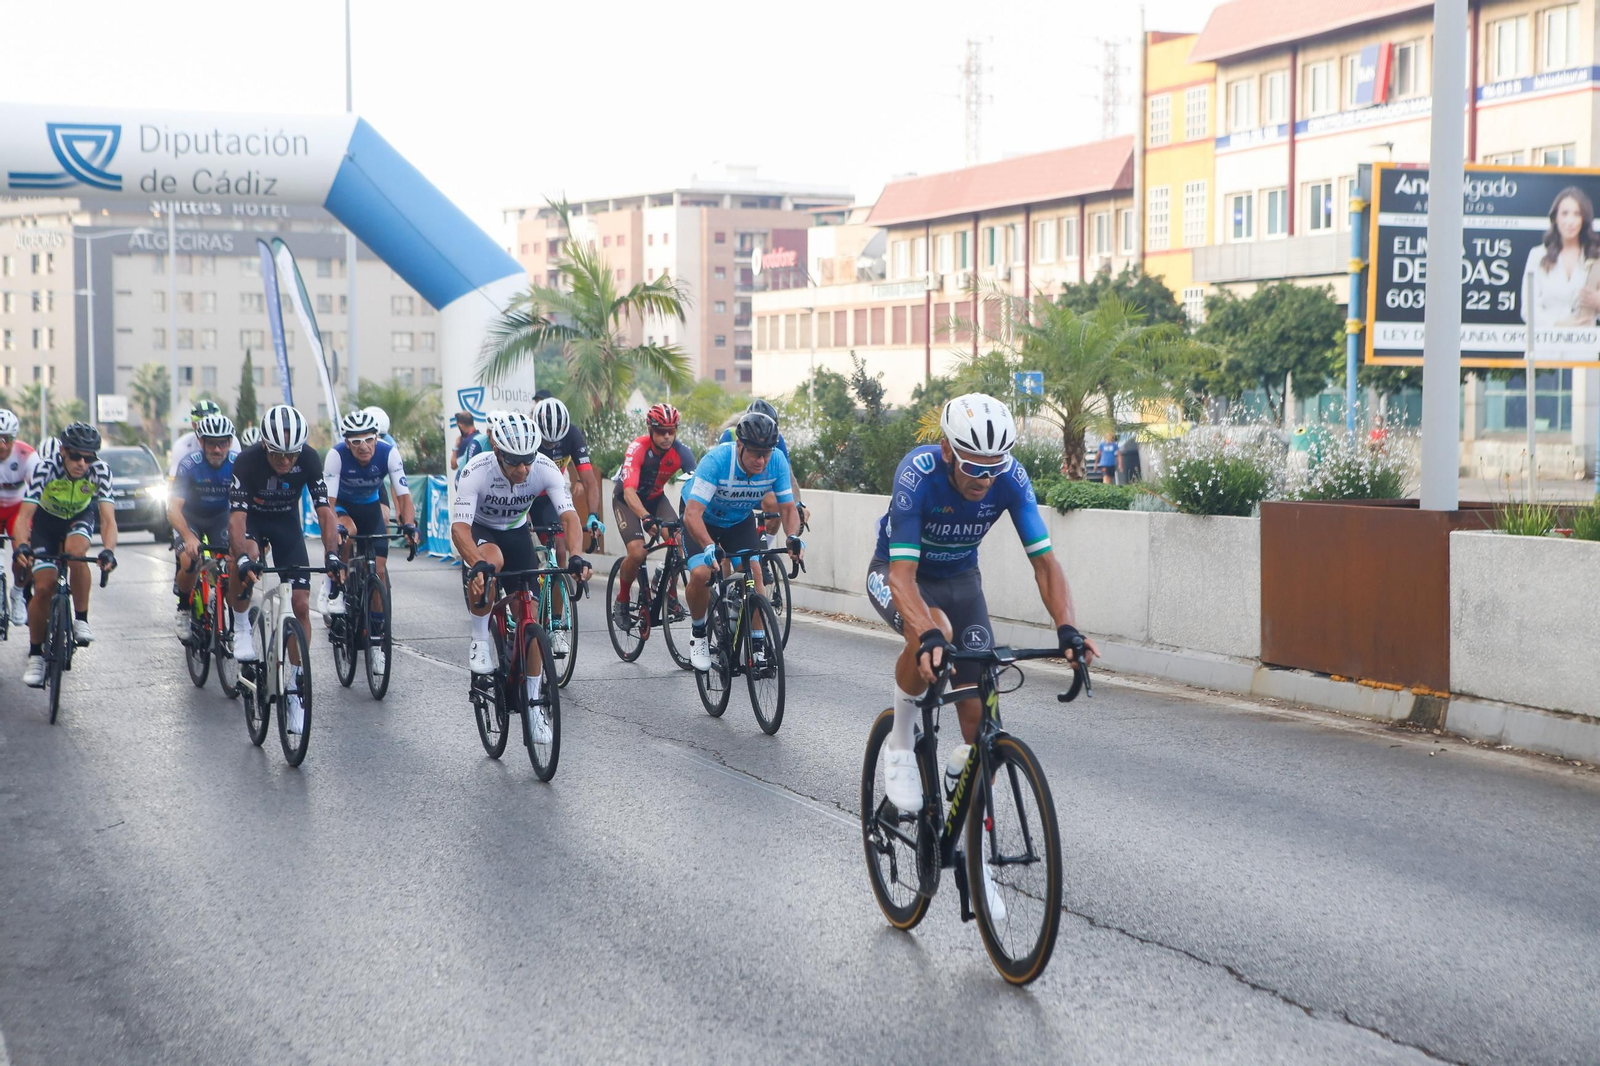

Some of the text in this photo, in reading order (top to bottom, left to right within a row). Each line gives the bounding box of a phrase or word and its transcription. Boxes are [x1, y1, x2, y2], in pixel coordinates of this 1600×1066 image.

[140, 124, 308, 159] Diputación
[140, 167, 278, 196] de Cádiz
[233, 202, 291, 217] HOTEL
[128, 231, 234, 252] ALGECIRAS
[1472, 238, 1512, 257] TUS
[1465, 290, 1491, 310] 22
[1497, 291, 1516, 311] 51
[1383, 329, 1409, 341] LEY
[484, 494, 536, 506] PROLONGO
[730, 489, 768, 499] MANILV
[925, 521, 991, 536] MIRANDA
